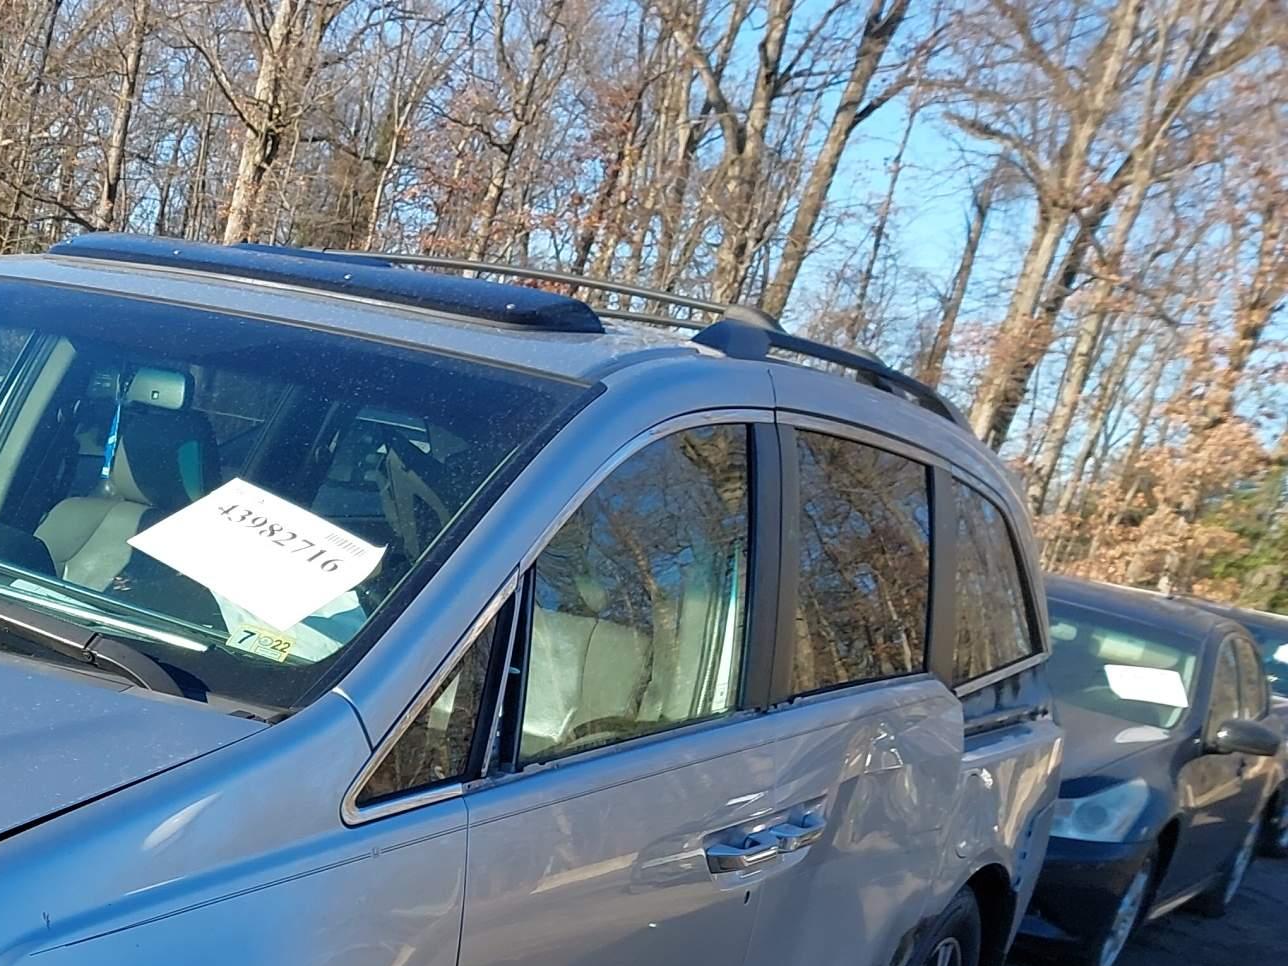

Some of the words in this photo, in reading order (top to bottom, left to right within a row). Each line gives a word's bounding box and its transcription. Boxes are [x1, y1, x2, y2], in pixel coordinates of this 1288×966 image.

[218, 504, 344, 572] 43982716
[237, 629, 257, 644] 7
[270, 639, 291, 654] 22
